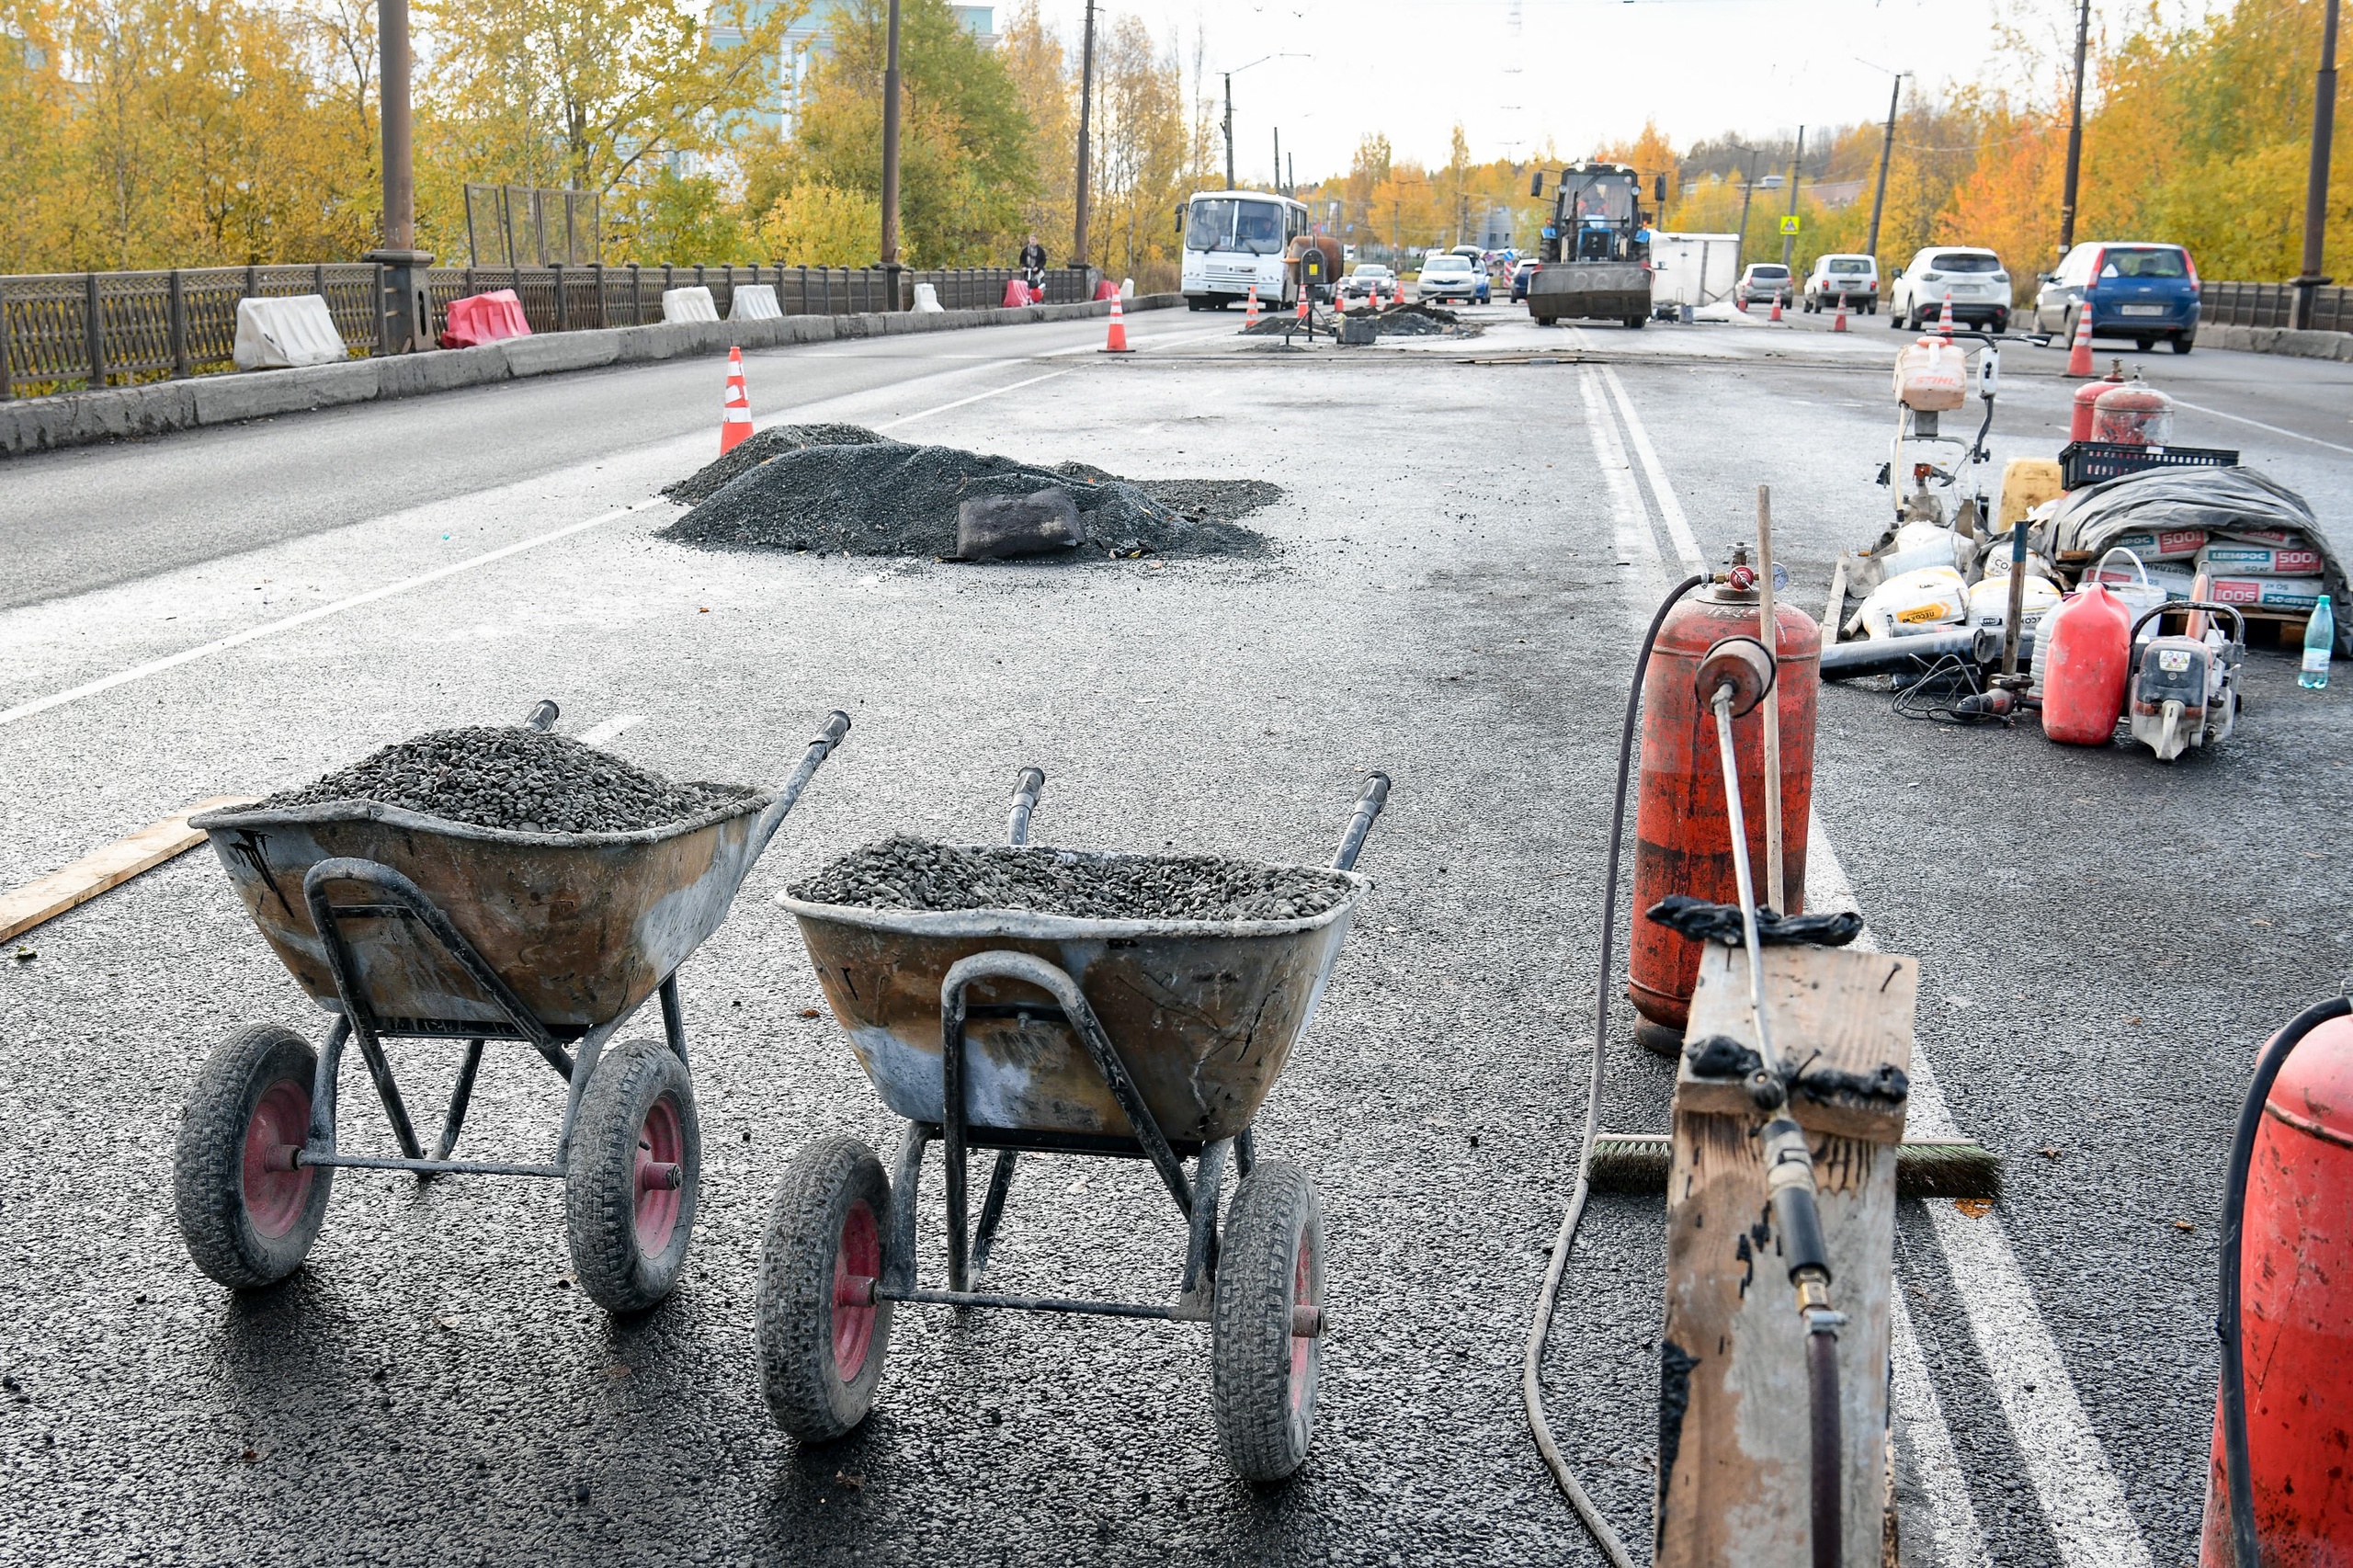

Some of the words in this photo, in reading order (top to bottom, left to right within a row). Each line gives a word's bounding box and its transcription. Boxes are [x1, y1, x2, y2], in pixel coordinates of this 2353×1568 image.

[1915, 376, 1956, 385] STIHL
[2163, 531, 2196, 545] 500
[2211, 552, 2267, 561] ЦЕМРОС
[2279, 552, 2313, 563] 500
[2145, 562, 2193, 576] ПОРТЛАН
[2222, 589, 2256, 602] 500
